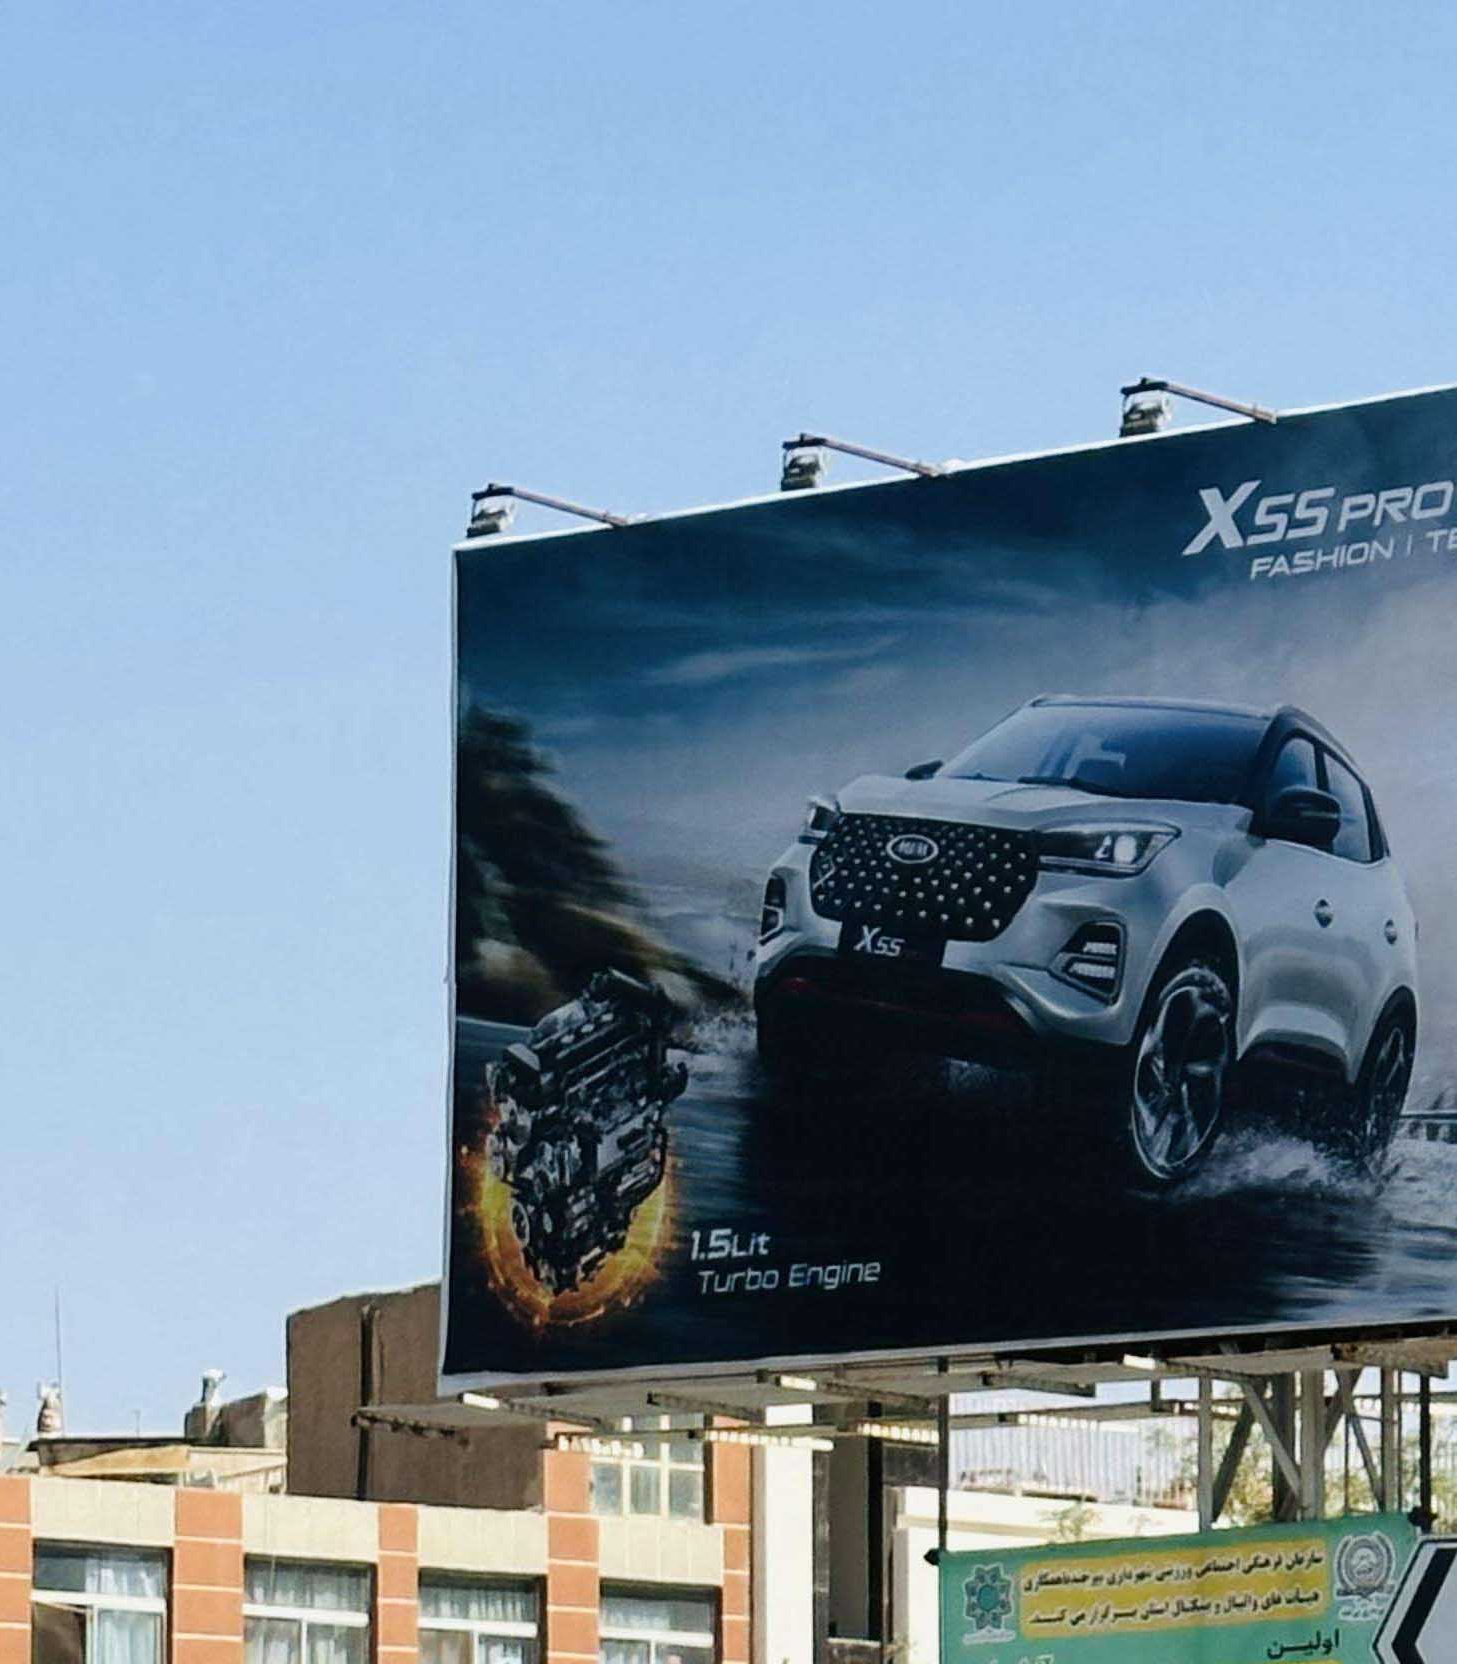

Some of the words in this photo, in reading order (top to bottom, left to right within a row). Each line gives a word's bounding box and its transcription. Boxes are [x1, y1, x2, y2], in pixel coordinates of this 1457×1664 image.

[1182, 480, 1336, 555] X55
[1338, 481, 1454, 533] PRO
[1250, 540, 1395, 580] FASHION
[698, 1268, 779, 1295] Turbo
[788, 1259, 881, 1293] Engine
[1267, 1629, 1340, 1660] اولین
